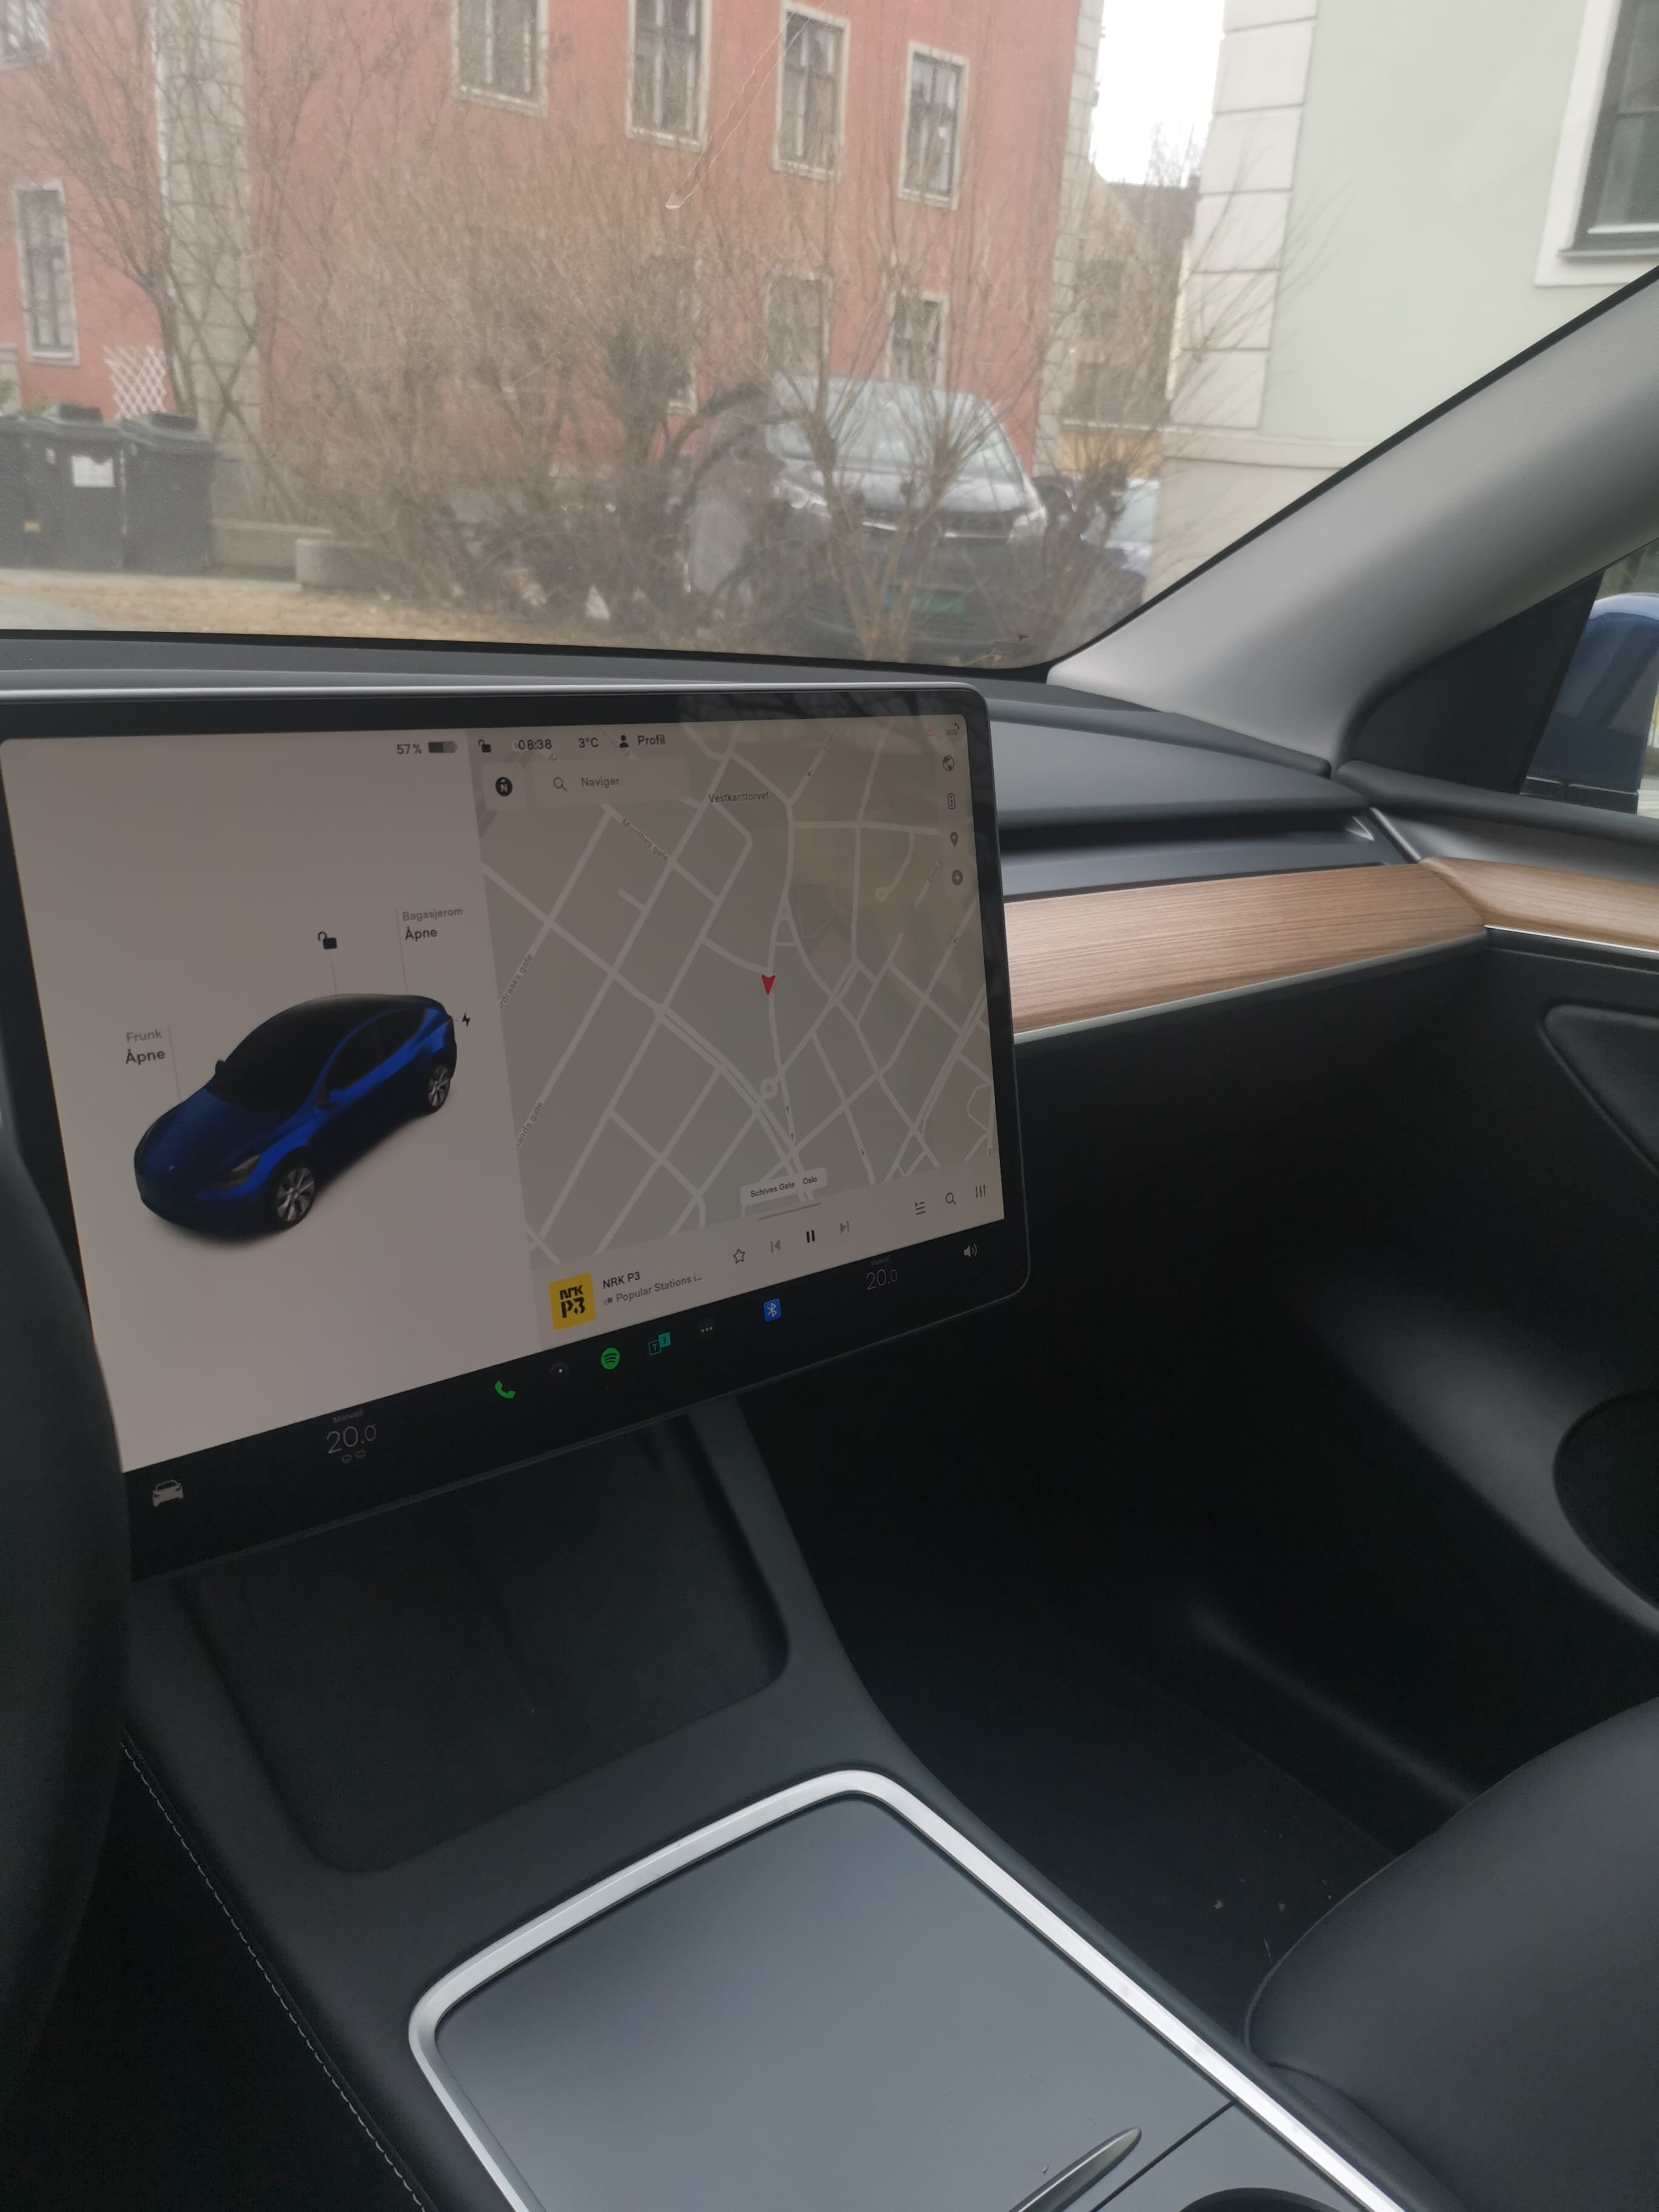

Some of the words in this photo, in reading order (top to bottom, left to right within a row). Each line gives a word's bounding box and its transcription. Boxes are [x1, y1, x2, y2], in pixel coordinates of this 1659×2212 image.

[517, 739, 552, 750] 08:38
[578, 737, 599, 748] 3°C
[637, 734, 666, 746] Profil
[396, 743, 423, 754] 57%
[580, 776, 620, 789] Naviger
[708, 791, 769, 803] Vestkanttorvet
[402, 908, 463, 922] Bagasjerom
[405, 926, 437, 942] Åpne
[126, 1028, 163, 1043] Frunk
[126, 1048, 166, 1066] Åpne
[802, 1176, 818, 1185] Oslo
[750, 1186, 778, 1198] Schives
[779, 1182, 796, 1191] Gate
[602, 1275, 625, 1290] NRK
[627, 1271, 642, 1283] P3
[866, 1269, 898, 1291] 20.0
[616, 1286, 653, 1303] Popular
[654, 1276, 692, 1292] Stations
[560, 1297, 586, 1318] P3
[326, 1424, 377, 1455] 20.0
